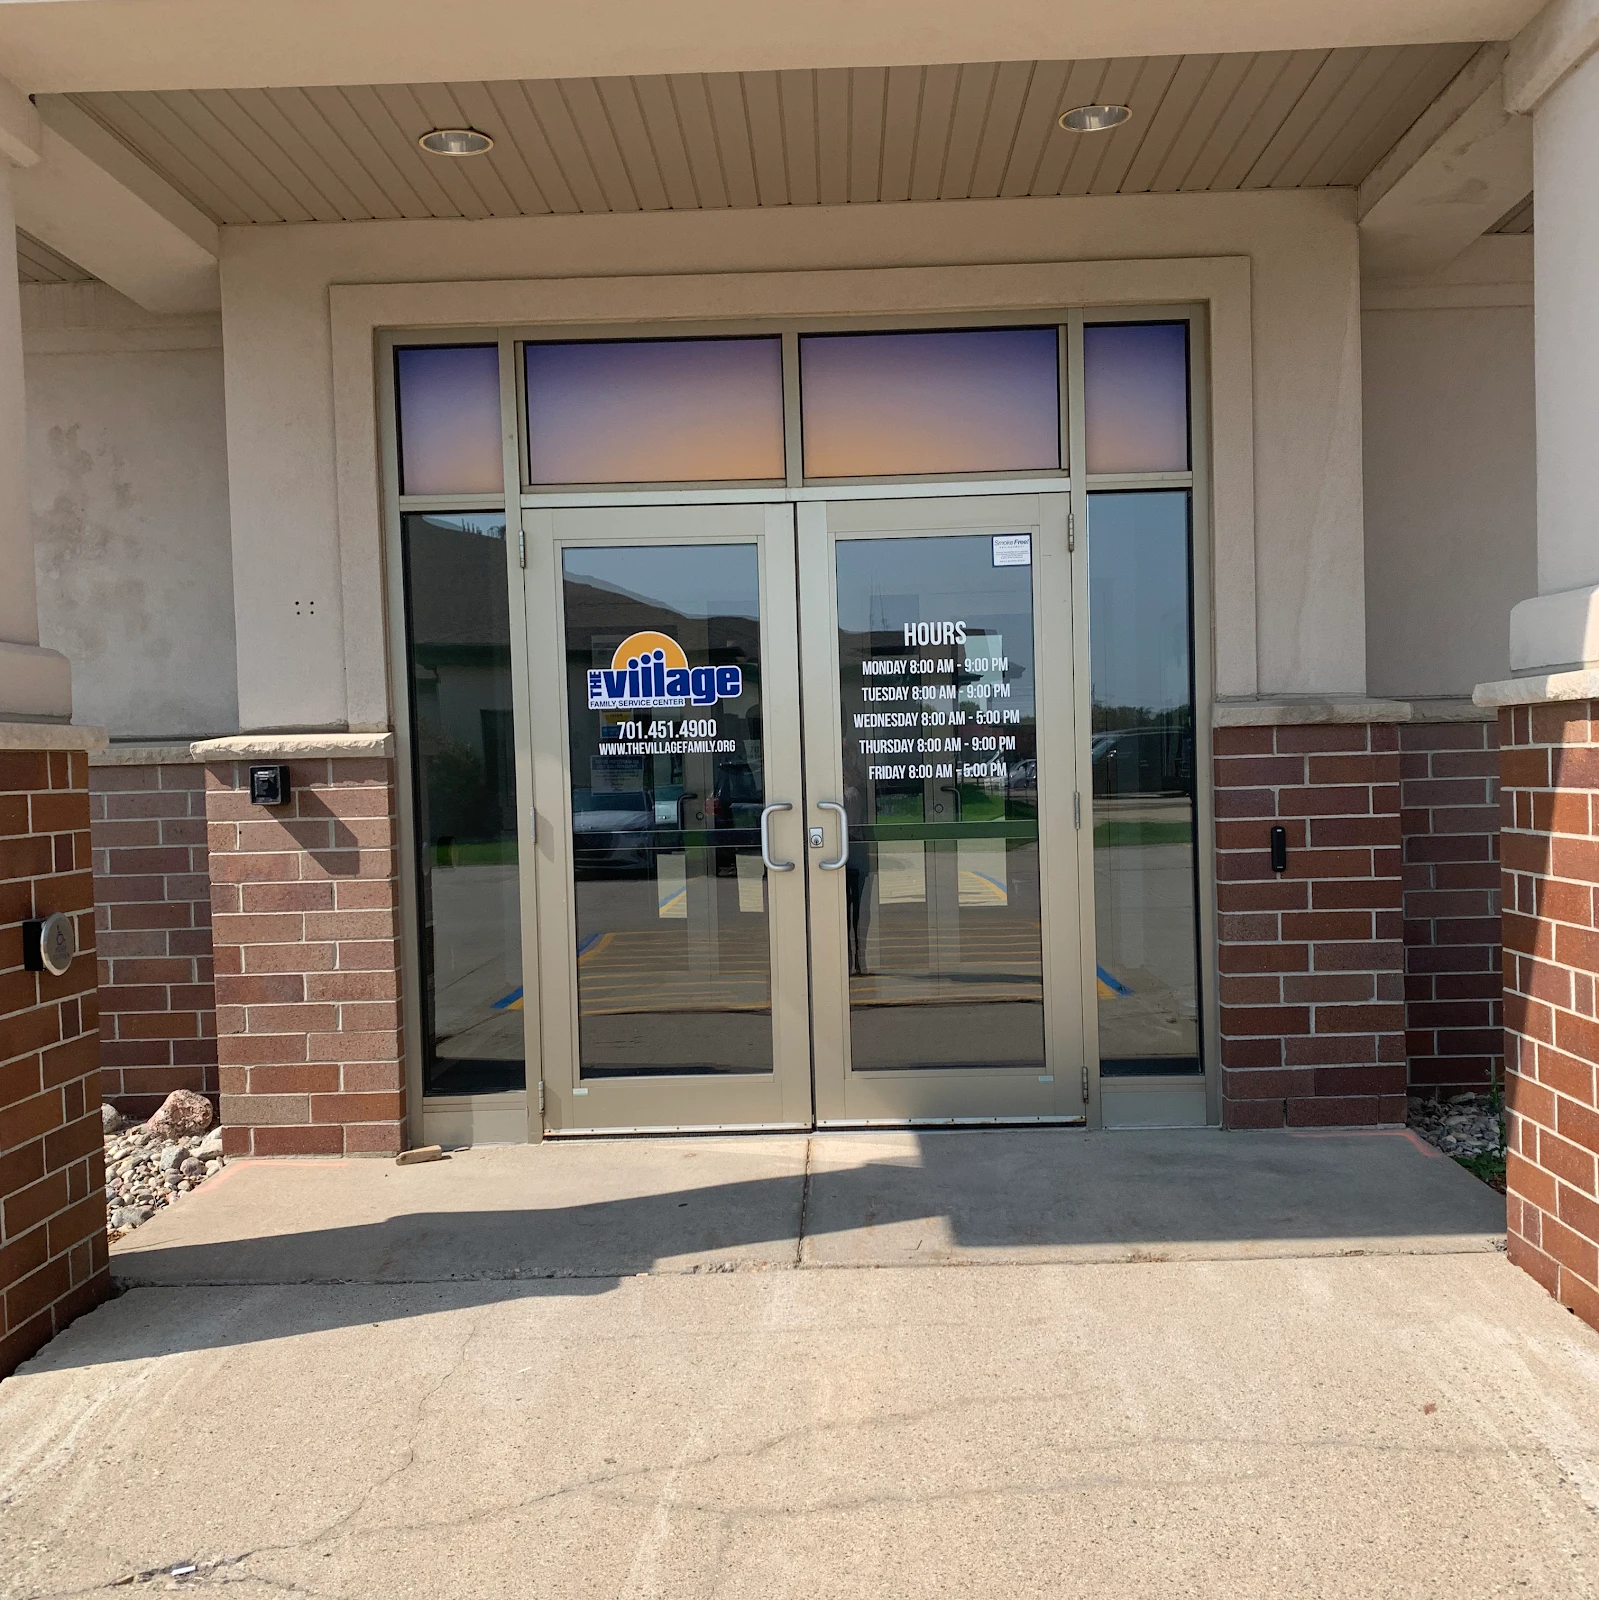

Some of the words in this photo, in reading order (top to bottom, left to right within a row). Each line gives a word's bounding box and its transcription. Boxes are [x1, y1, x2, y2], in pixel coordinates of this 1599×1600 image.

[904, 621, 966, 646] HOURS
[862, 660, 906, 675] MONDAY
[910, 660, 934, 674] 8:00
[937, 659, 954, 673] AM
[965, 658, 988, 672] 9:00
[992, 657, 1008, 671] PM
[590, 671, 602, 698] THE
[603, 650, 740, 704] village
[862, 687, 909, 702] TUESDAY
[912, 686, 936, 700] 8:00
[939, 685, 956, 699] AM
[967, 684, 990, 698] 9:00
[994, 684, 1010, 697] PM
[853, 713, 918, 728] WEDNESDAY
[921, 712, 945, 726] 8:00
[948, 711, 965, 725] AM
[976, 710, 1000, 724] 5:00
[1003, 710, 1020, 724] PM
[617, 719, 717, 739] 701.451.4900
[599, 740, 736, 755] WWW.THEVILLAGEFAMILY.ORG
[859, 739, 915, 754] THURSDAY
[917, 738, 941, 752] 8:00
[944, 738, 961, 751] AM
[972, 737, 996, 750] 9:00
[999, 736, 1015, 750] PM
[869, 765, 906, 780] FRIDAY
[909, 764, 932, 778] 8:00
[936, 764, 952, 777] AM
[963, 763, 987, 777] 5:00
[990, 762, 1006, 776] PM
